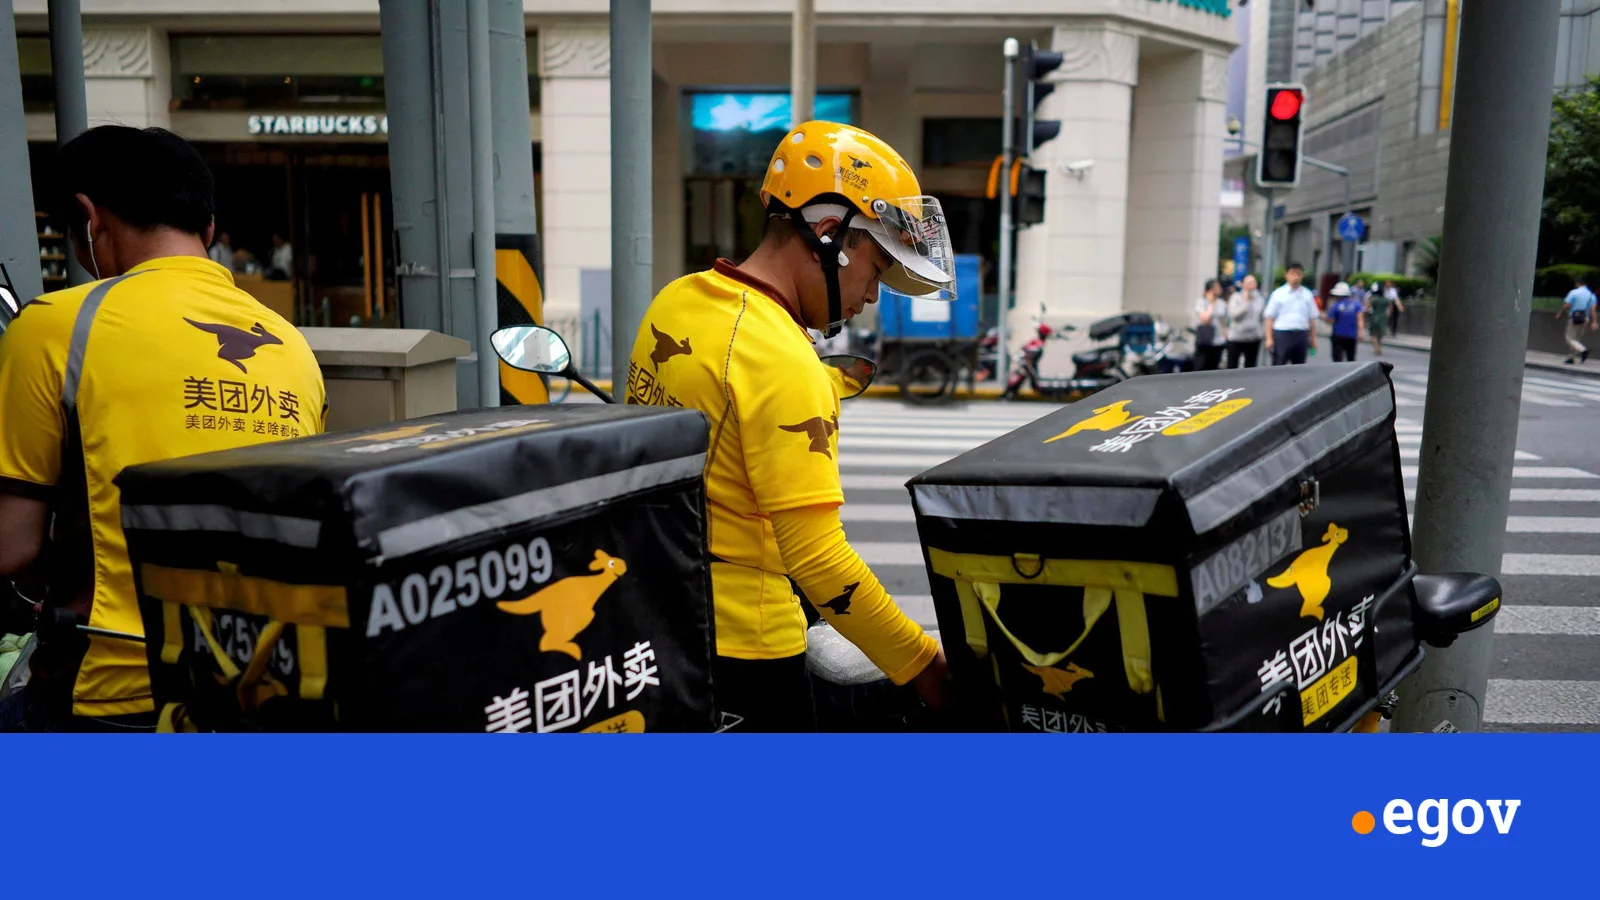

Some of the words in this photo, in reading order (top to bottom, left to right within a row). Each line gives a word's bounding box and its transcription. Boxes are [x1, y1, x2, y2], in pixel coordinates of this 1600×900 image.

[248, 115, 377, 134] STARBUCKS
[184, 376, 300, 423] 美团外卖
[185, 414, 246, 433] 美团外卖
[366, 536, 553, 637] A025099
[484, 640, 660, 733] 美团外卖
[1303, 664, 1352, 716] 美团专送
